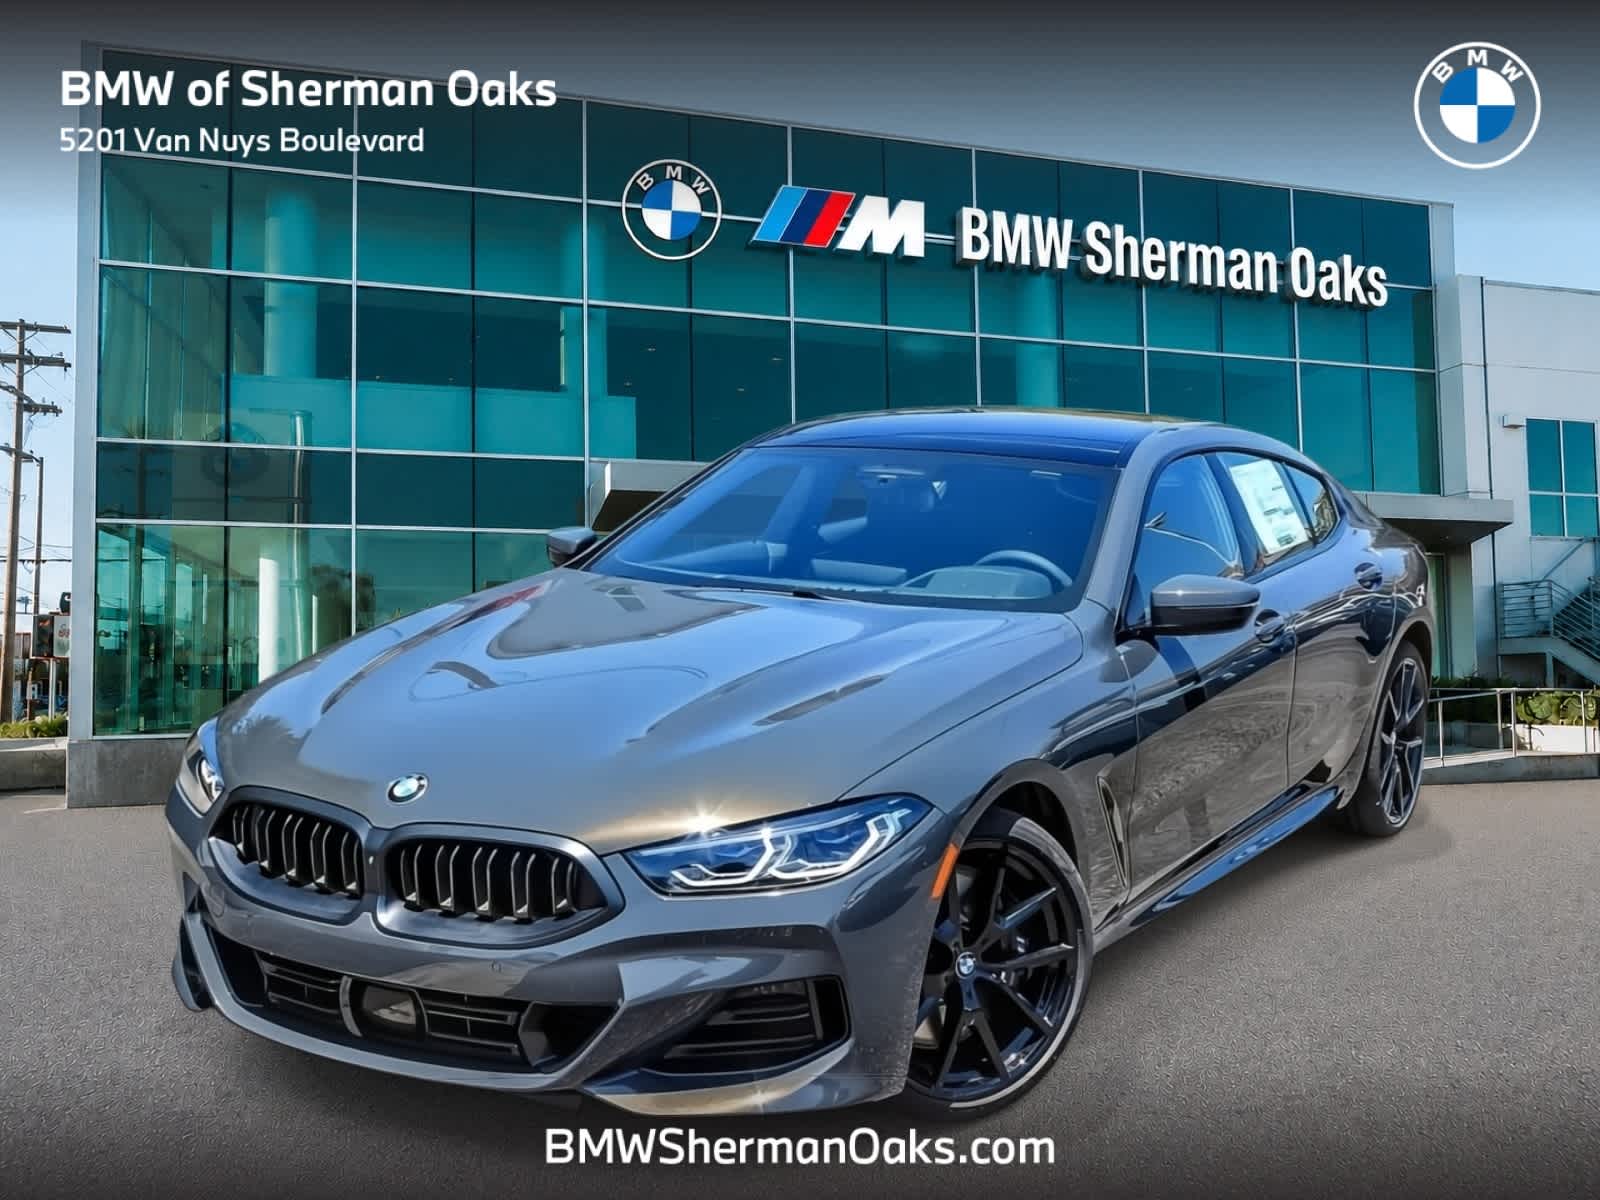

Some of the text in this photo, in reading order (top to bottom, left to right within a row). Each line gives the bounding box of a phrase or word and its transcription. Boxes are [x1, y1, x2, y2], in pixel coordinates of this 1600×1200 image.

[636, 165, 711, 195] BMW
[962, 207, 1388, 307] BMW Sherman Oaks
